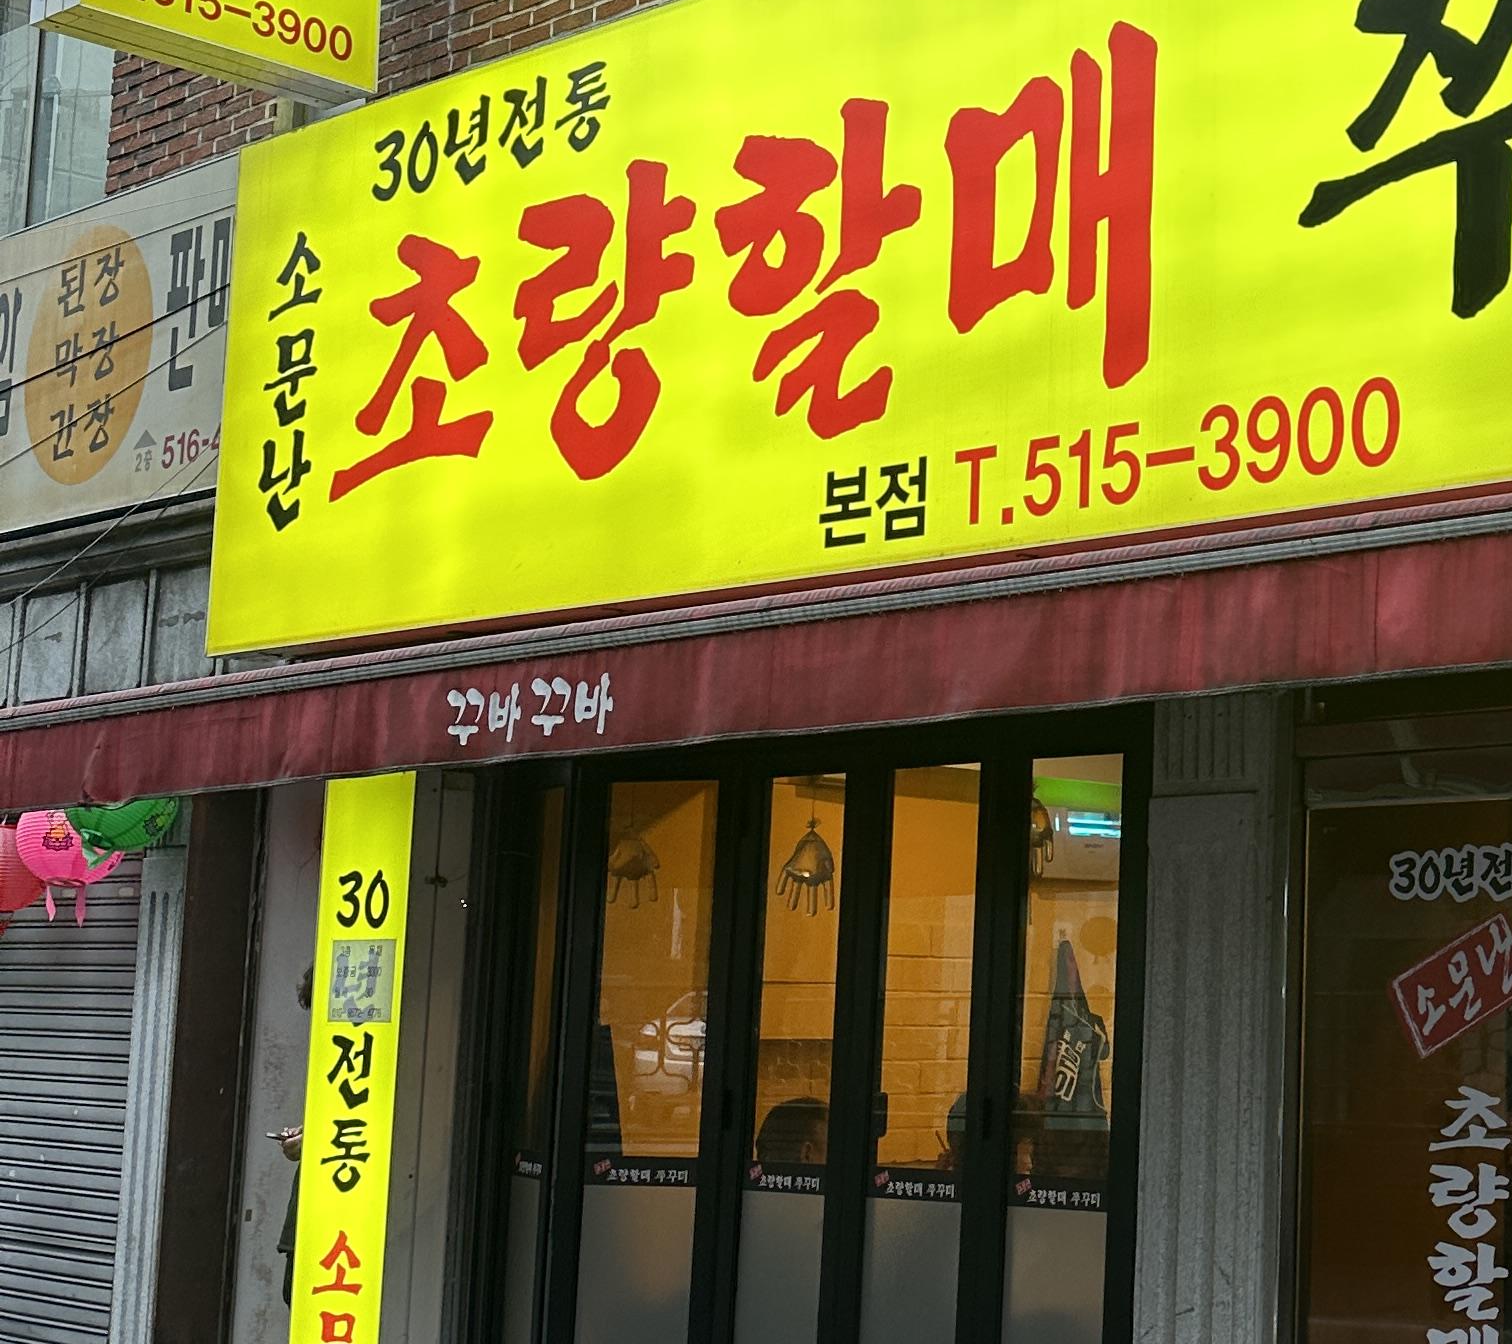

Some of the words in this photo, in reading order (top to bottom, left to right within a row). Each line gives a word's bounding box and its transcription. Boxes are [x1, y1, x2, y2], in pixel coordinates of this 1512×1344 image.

[371, 60, 611, 202] 30년전통
[57, 246, 125, 318] 된장
[328, 20, 1159, 502] 초량할매
[54, 324, 120, 388] 막장
[258, 230, 323, 533] 소문난
[49, 393, 116, 463] 간장
[818, 455, 929, 549] 본점
[954, 376, 1401, 527] T.515-3900
